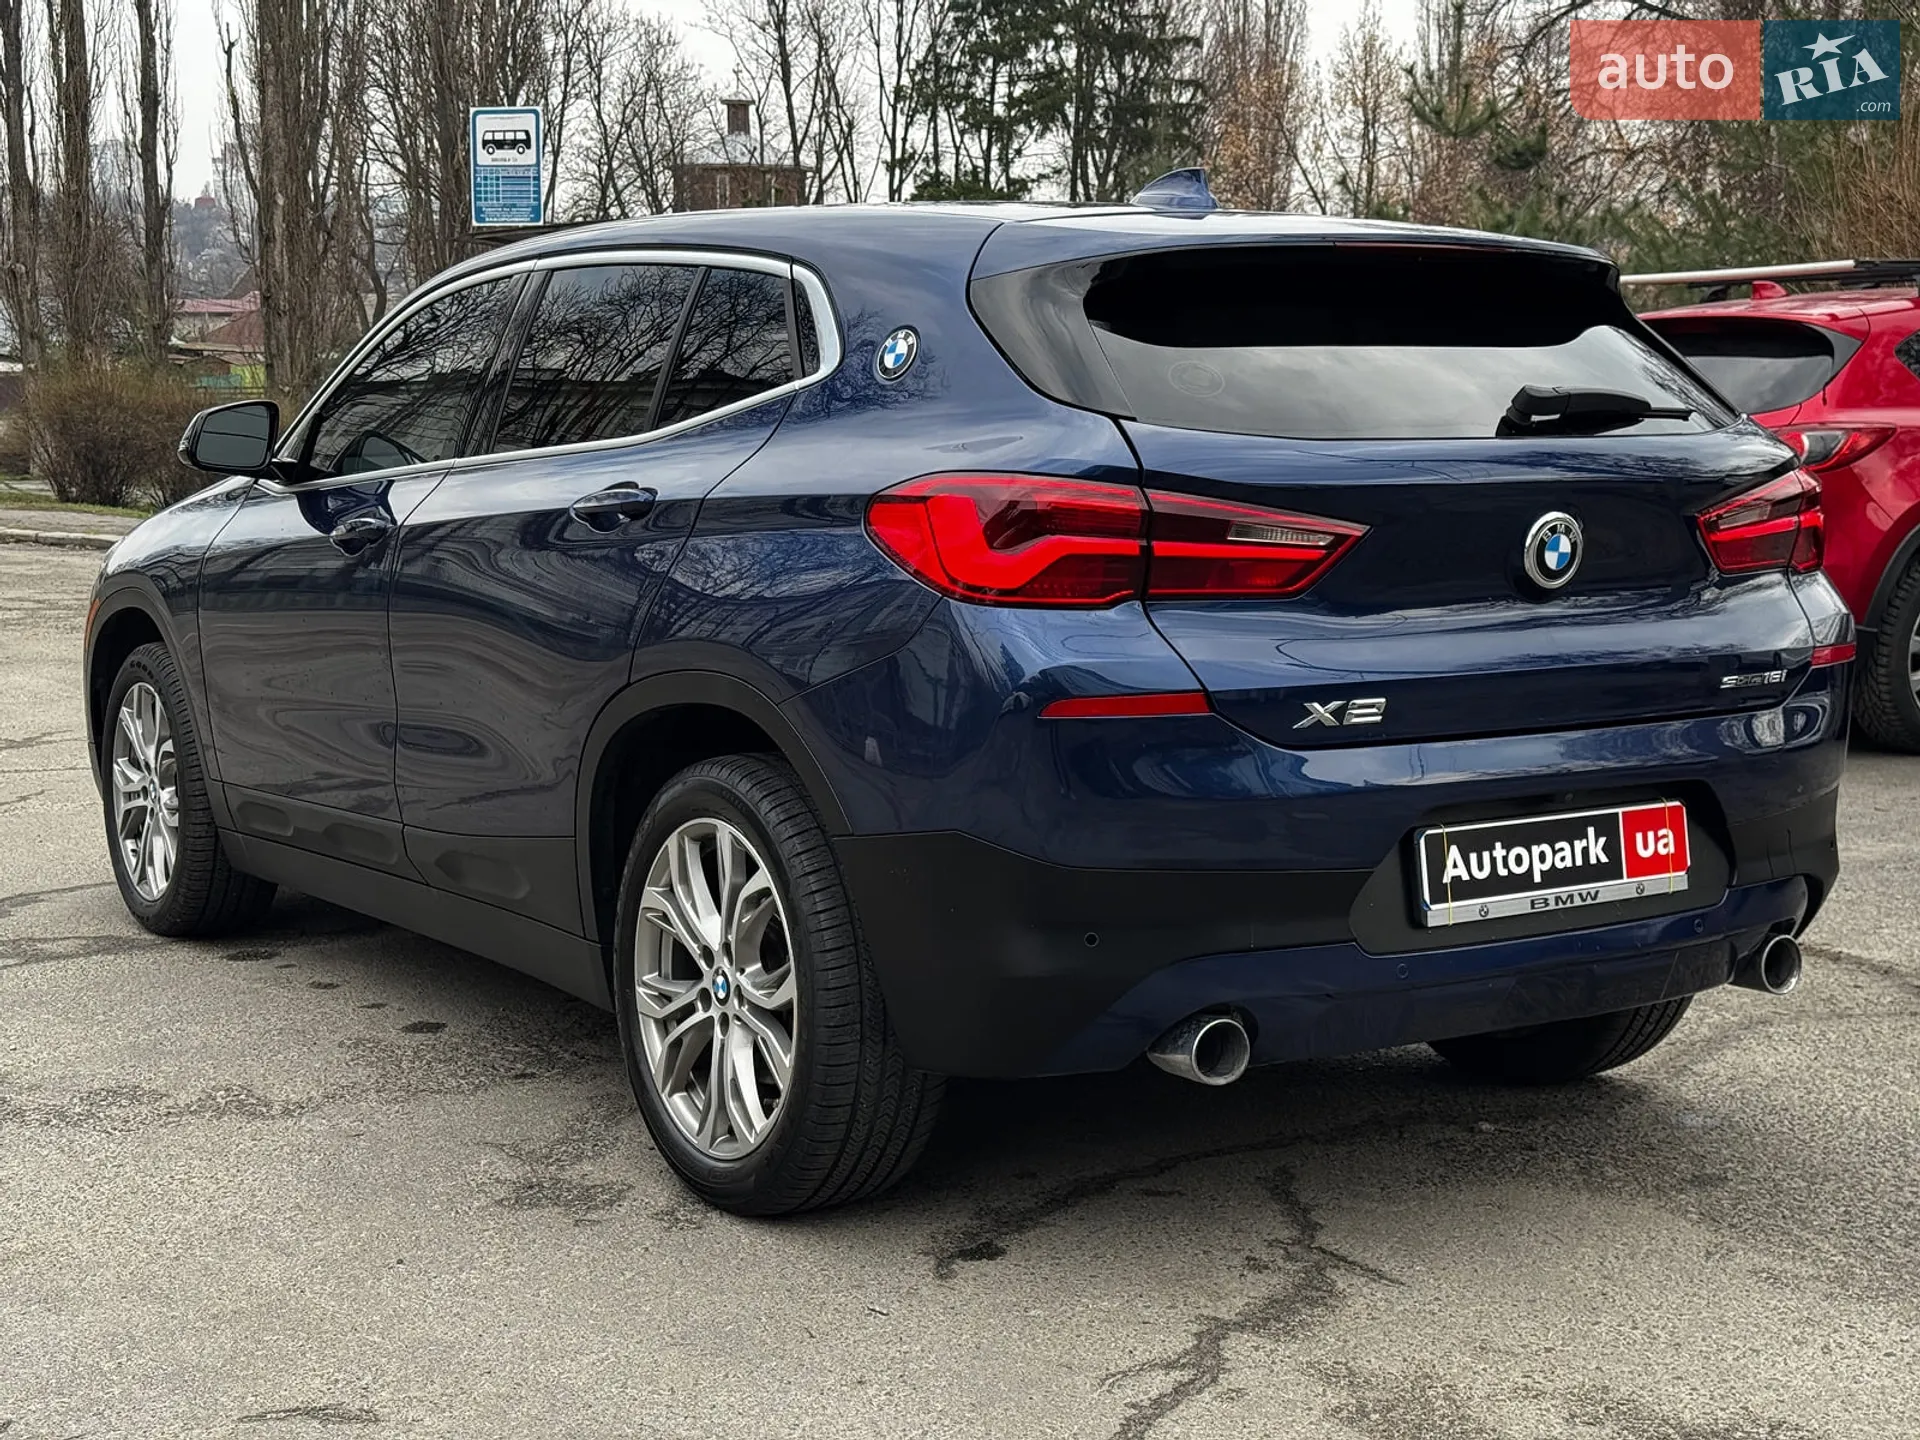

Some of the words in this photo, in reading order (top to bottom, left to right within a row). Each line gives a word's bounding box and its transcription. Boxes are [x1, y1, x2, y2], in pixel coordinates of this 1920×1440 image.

[1292, 697, 1387, 729] X2
[1442, 826, 1609, 883] Autopark
[1635, 827, 1675, 858] ua
[1530, 890, 1600, 910] BMW
